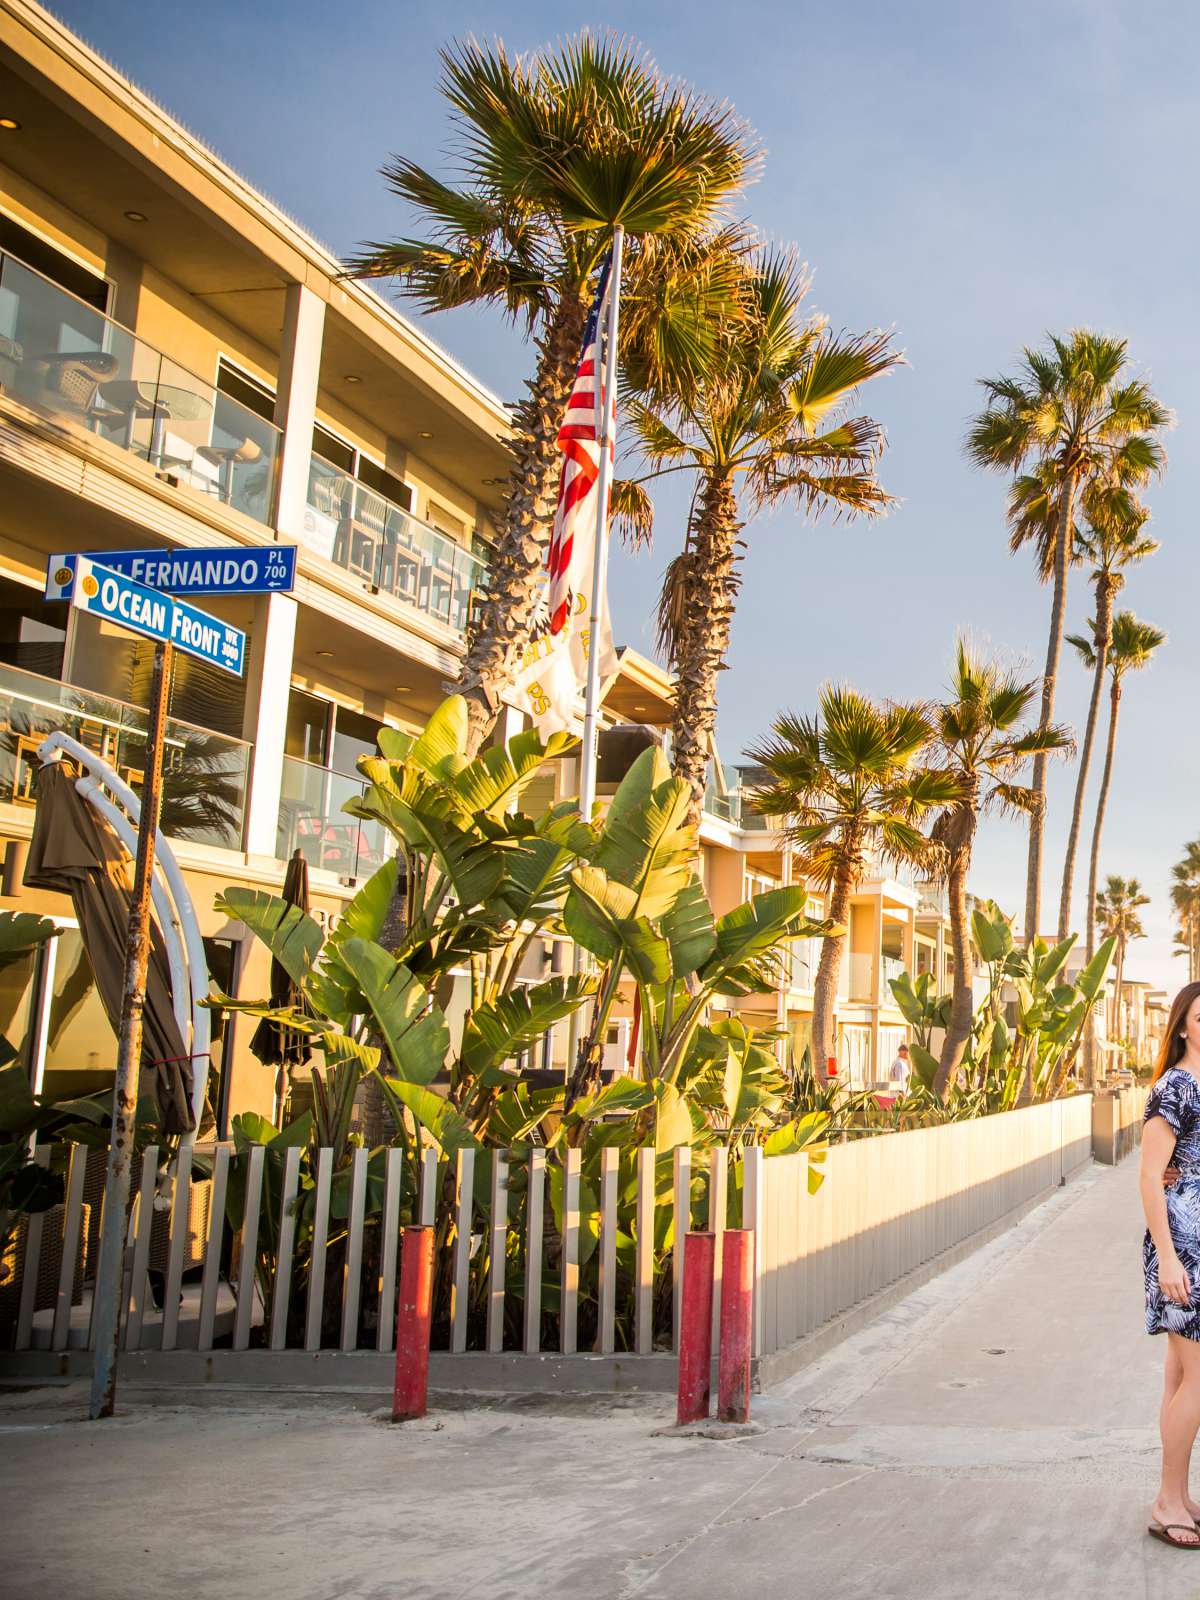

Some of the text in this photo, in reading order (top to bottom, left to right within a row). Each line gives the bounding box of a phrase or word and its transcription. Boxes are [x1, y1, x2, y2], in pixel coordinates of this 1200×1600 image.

[269, 551, 284, 563] PL
[131, 558, 258, 586] FERNANDO
[264, 566, 287, 579] 700
[101, 578, 221, 657] OCEAN FRONT
